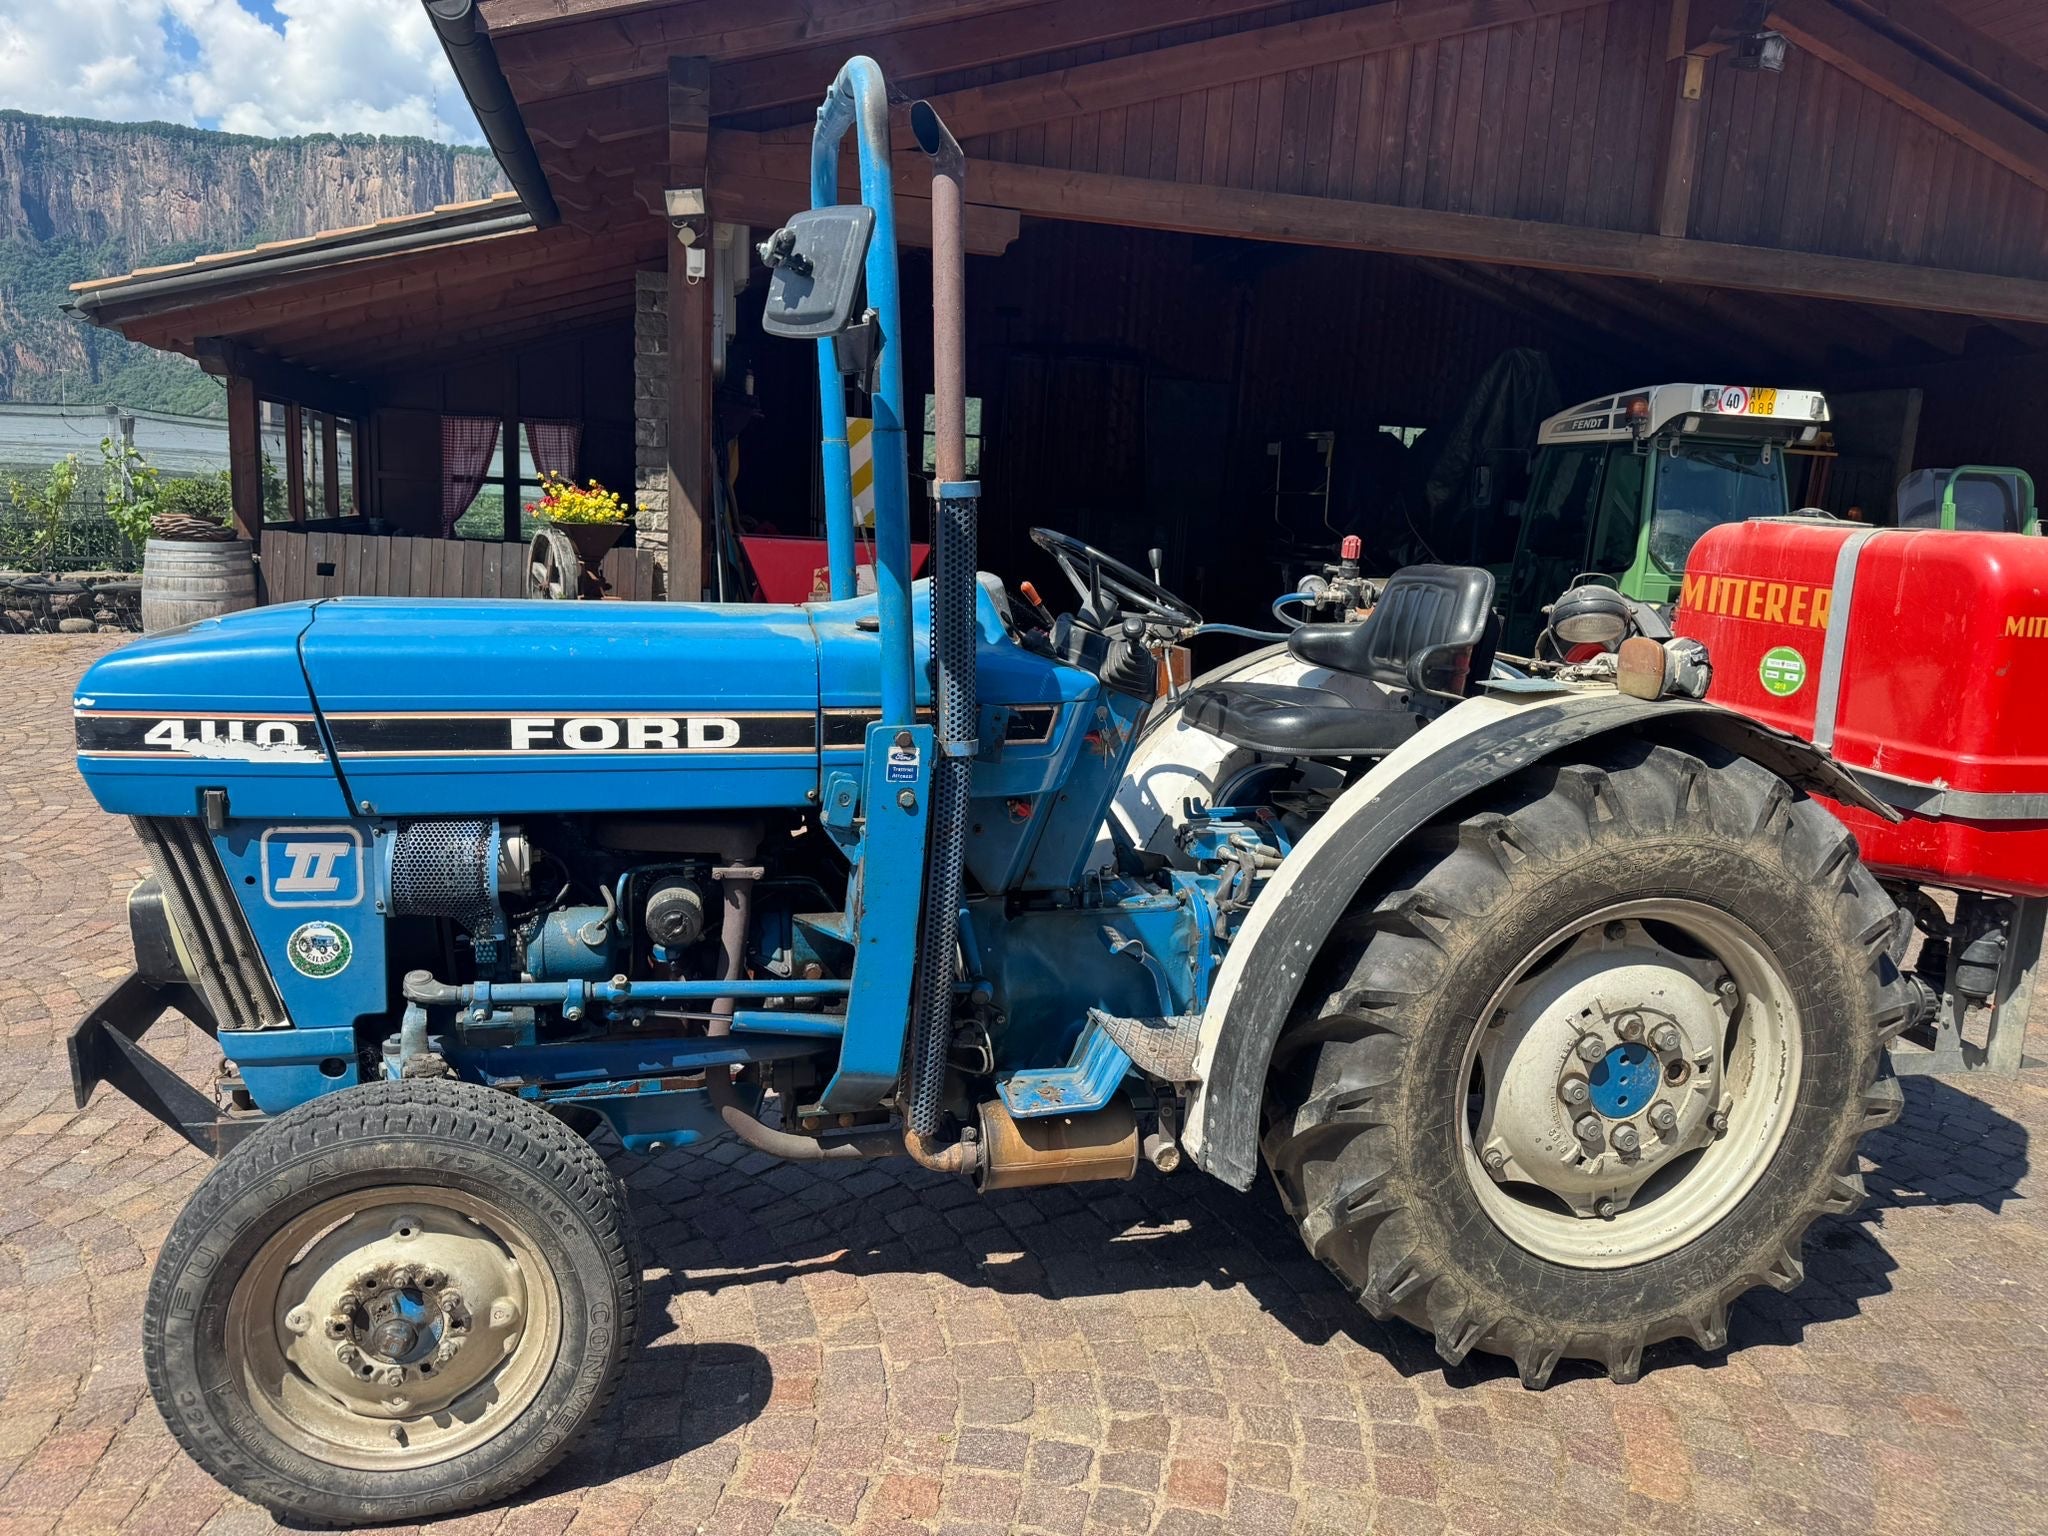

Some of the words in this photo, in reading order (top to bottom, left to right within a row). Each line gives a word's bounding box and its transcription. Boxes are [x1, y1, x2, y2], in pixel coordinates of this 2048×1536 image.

[1571, 418, 1604, 430] FENDT
[1726, 393, 1740, 409] 40
[1680, 573, 1833, 629] MITTERER
[510, 718, 740, 749] FORD
[424, 1150, 579, 1240] 175/75R16C
[170, 1158, 345, 1322] FULDA
[534, 1301, 610, 1454] CONVEO
